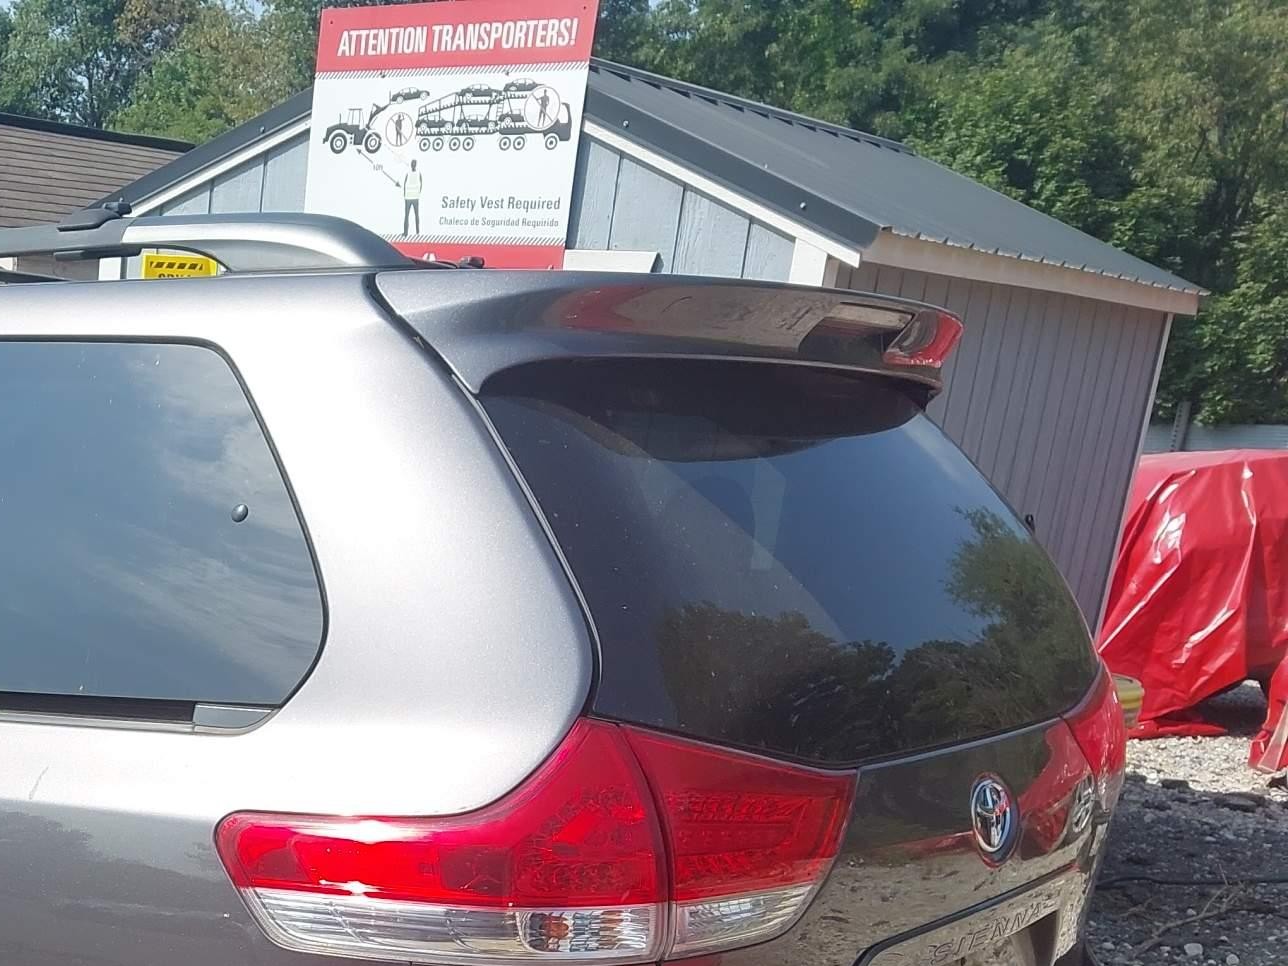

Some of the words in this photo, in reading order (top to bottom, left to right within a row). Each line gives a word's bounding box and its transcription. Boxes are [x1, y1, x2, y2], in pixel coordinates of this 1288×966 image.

[337, 25, 427, 56] ATTENTION
[432, 18, 579, 52] TRANSPORTERS!
[441, 195, 476, 212] Safety
[480, 196, 505, 209] Vest
[507, 196, 561, 213] Required
[439, 216, 469, 226] Chaleco
[470, 217, 479, 226] de
